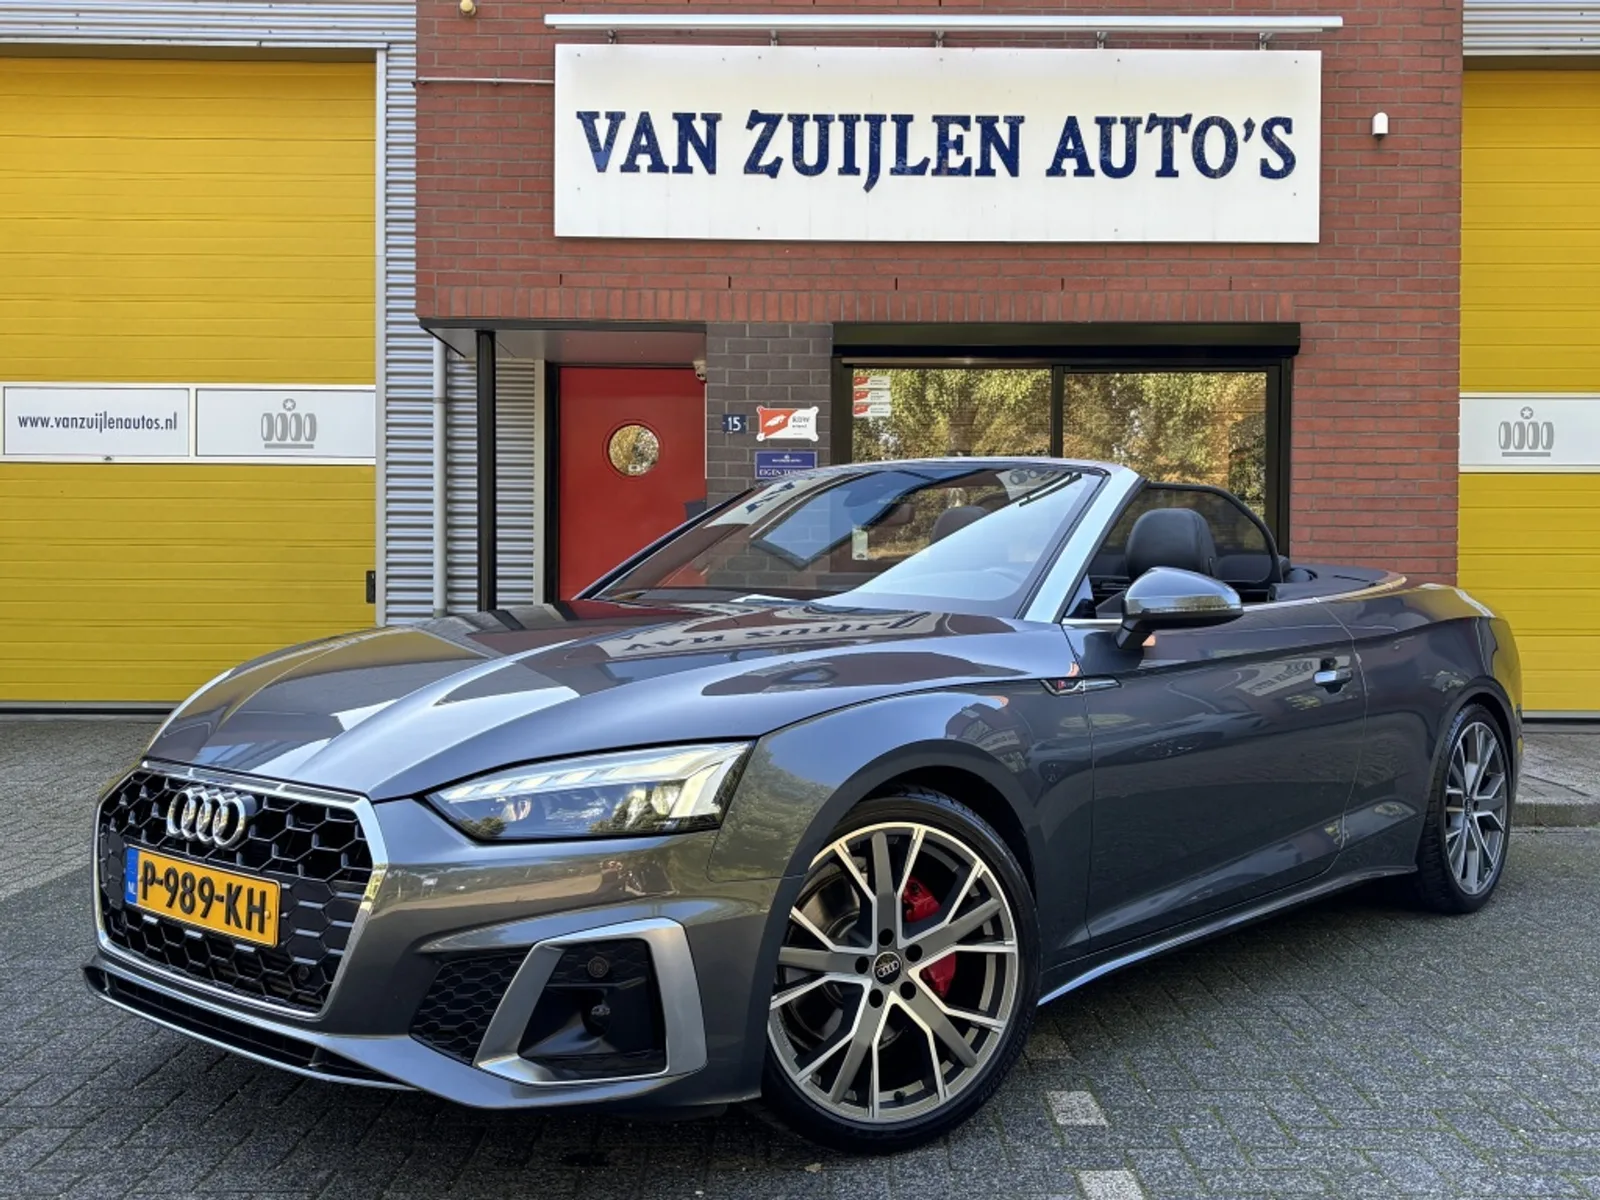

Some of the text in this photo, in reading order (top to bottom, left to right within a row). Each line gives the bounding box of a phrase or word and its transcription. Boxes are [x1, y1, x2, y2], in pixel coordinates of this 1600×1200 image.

[577, 110, 1297, 192] VAN ZUIJLEN AUTO'S
[18, 411, 177, 433] www.vanzuijlenautos.nl
[728, 416, 741, 431] 15
[140, 859, 267, 934] P-989-KH
